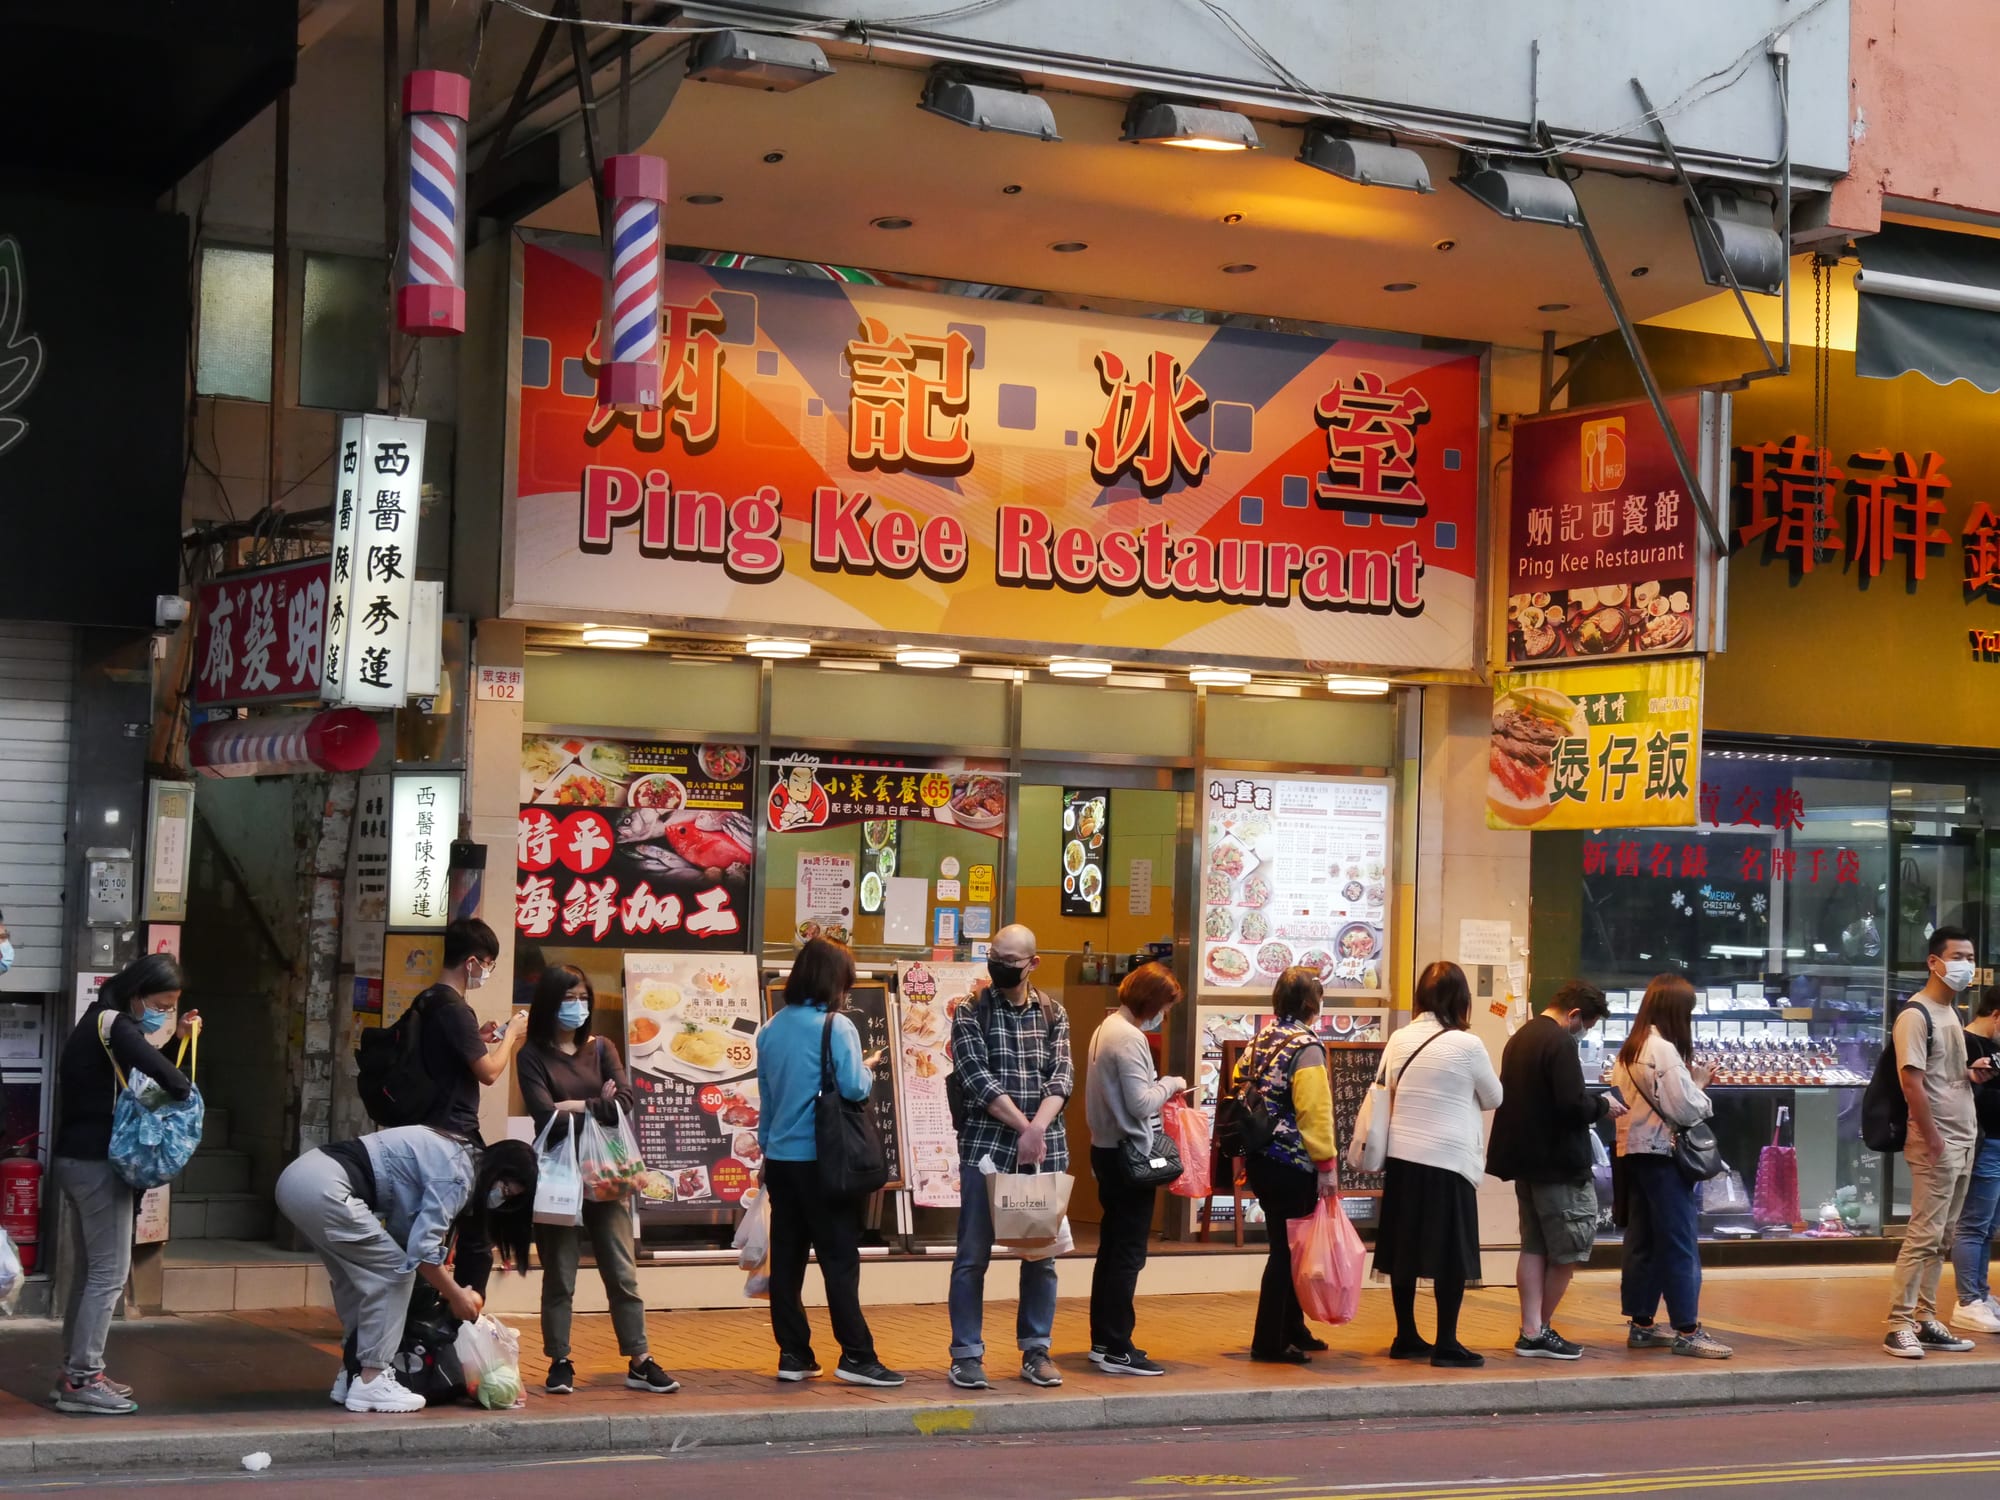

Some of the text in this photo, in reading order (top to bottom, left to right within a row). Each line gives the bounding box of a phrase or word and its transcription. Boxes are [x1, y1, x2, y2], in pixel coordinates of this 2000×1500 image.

[1527, 490, 1681, 547] 炳記西餐館
[1733, 435, 1952, 580] 瑋祥
[326, 440, 358, 685] 西醫陳秀蓮
[579, 465, 1425, 617] Ping Kee Restaurant
[1518, 542, 1685, 579] Ping Kee Restaurant
[360, 441, 410, 689] 西醫陳秀蓮
[488, 685, 514, 698] 102
[823, 773, 919, 804] 小菜套餐
[922, 780, 950, 799] $65
[1549, 731, 1690, 804] 煲仔飯
[411, 786, 436, 918] 西醫陳秀蓮
[518, 813, 610, 870] 特平
[1583, 841, 1860, 885] 新舊名錶 名牌手袋
[515, 874, 739, 942] 海鮮加工
[1703, 901, 1742, 910] CHRISTMAS
[1709, 891, 1736, 901] MERRY
[727, 1047, 752, 1061] $53
[701, 1093, 722, 1105] $50
[1009, 1193, 1046, 1208] brotzeit
